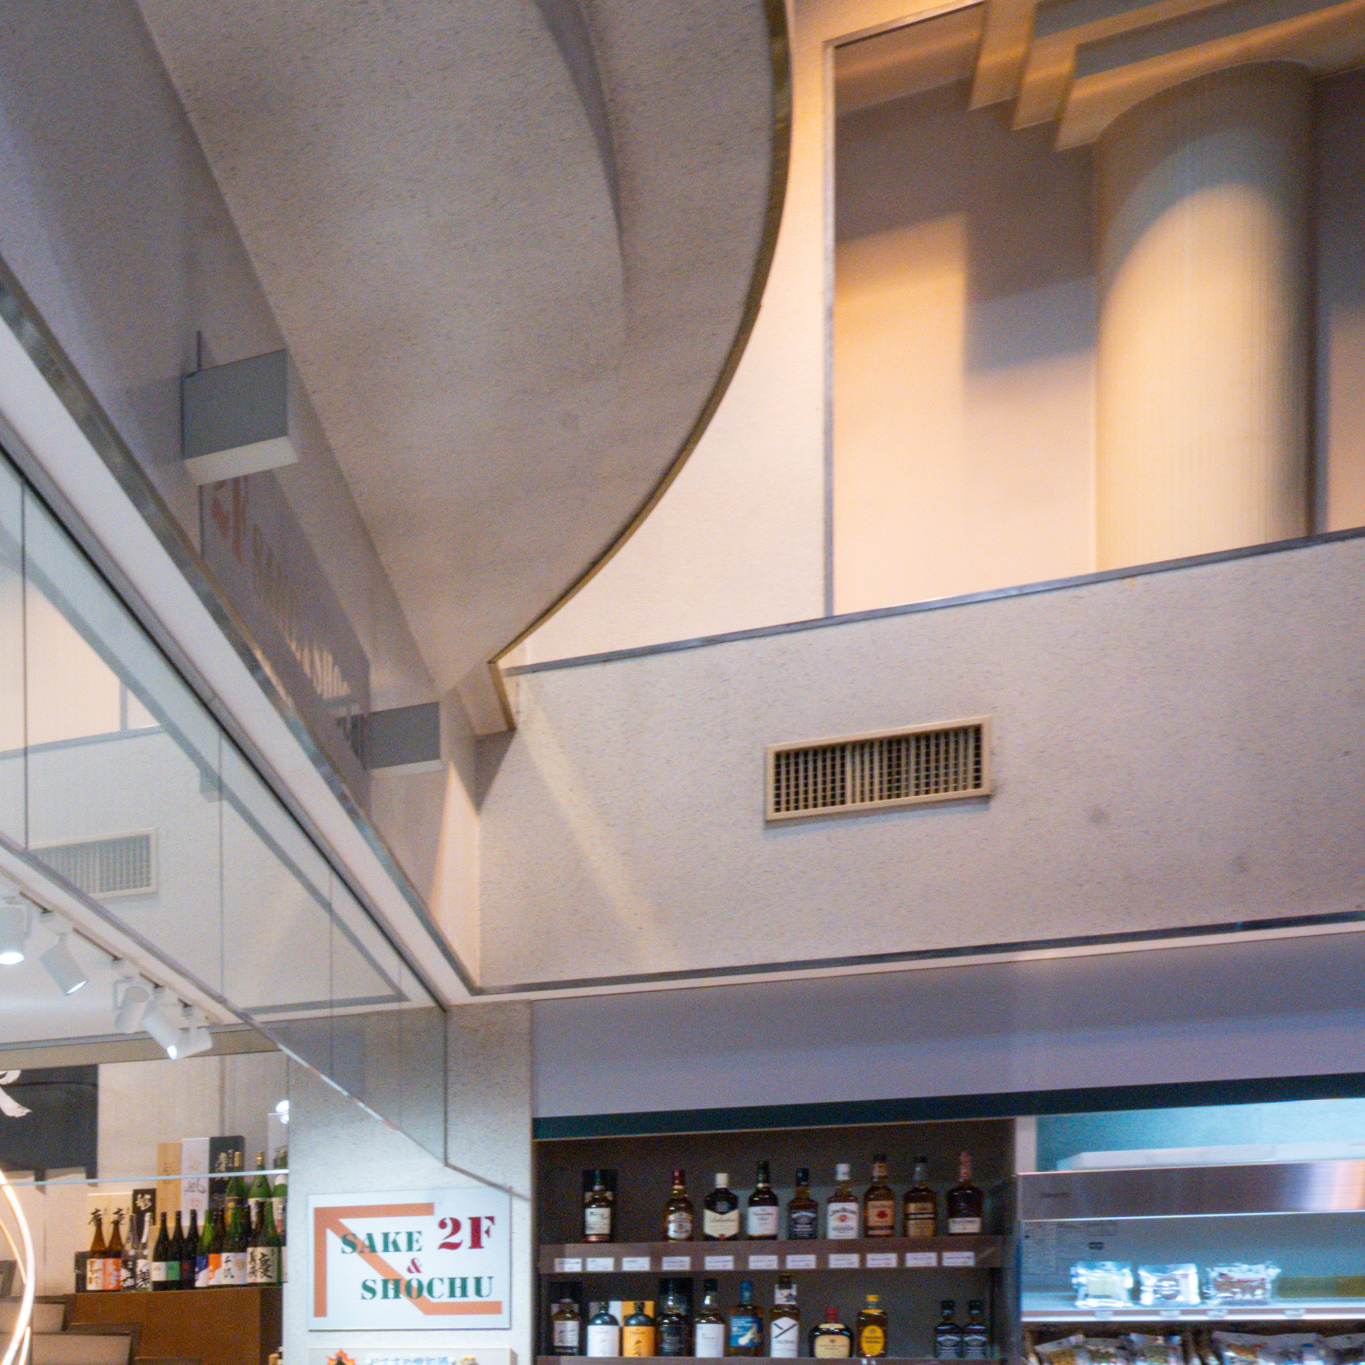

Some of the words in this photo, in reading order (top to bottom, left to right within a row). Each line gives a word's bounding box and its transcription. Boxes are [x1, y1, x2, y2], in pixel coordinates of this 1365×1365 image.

[340, 1231, 424, 1255] SAKE
[437, 1216, 496, 1250] 2F
[406, 1257, 423, 1274] &
[360, 1276, 494, 1300] SHOCHU
